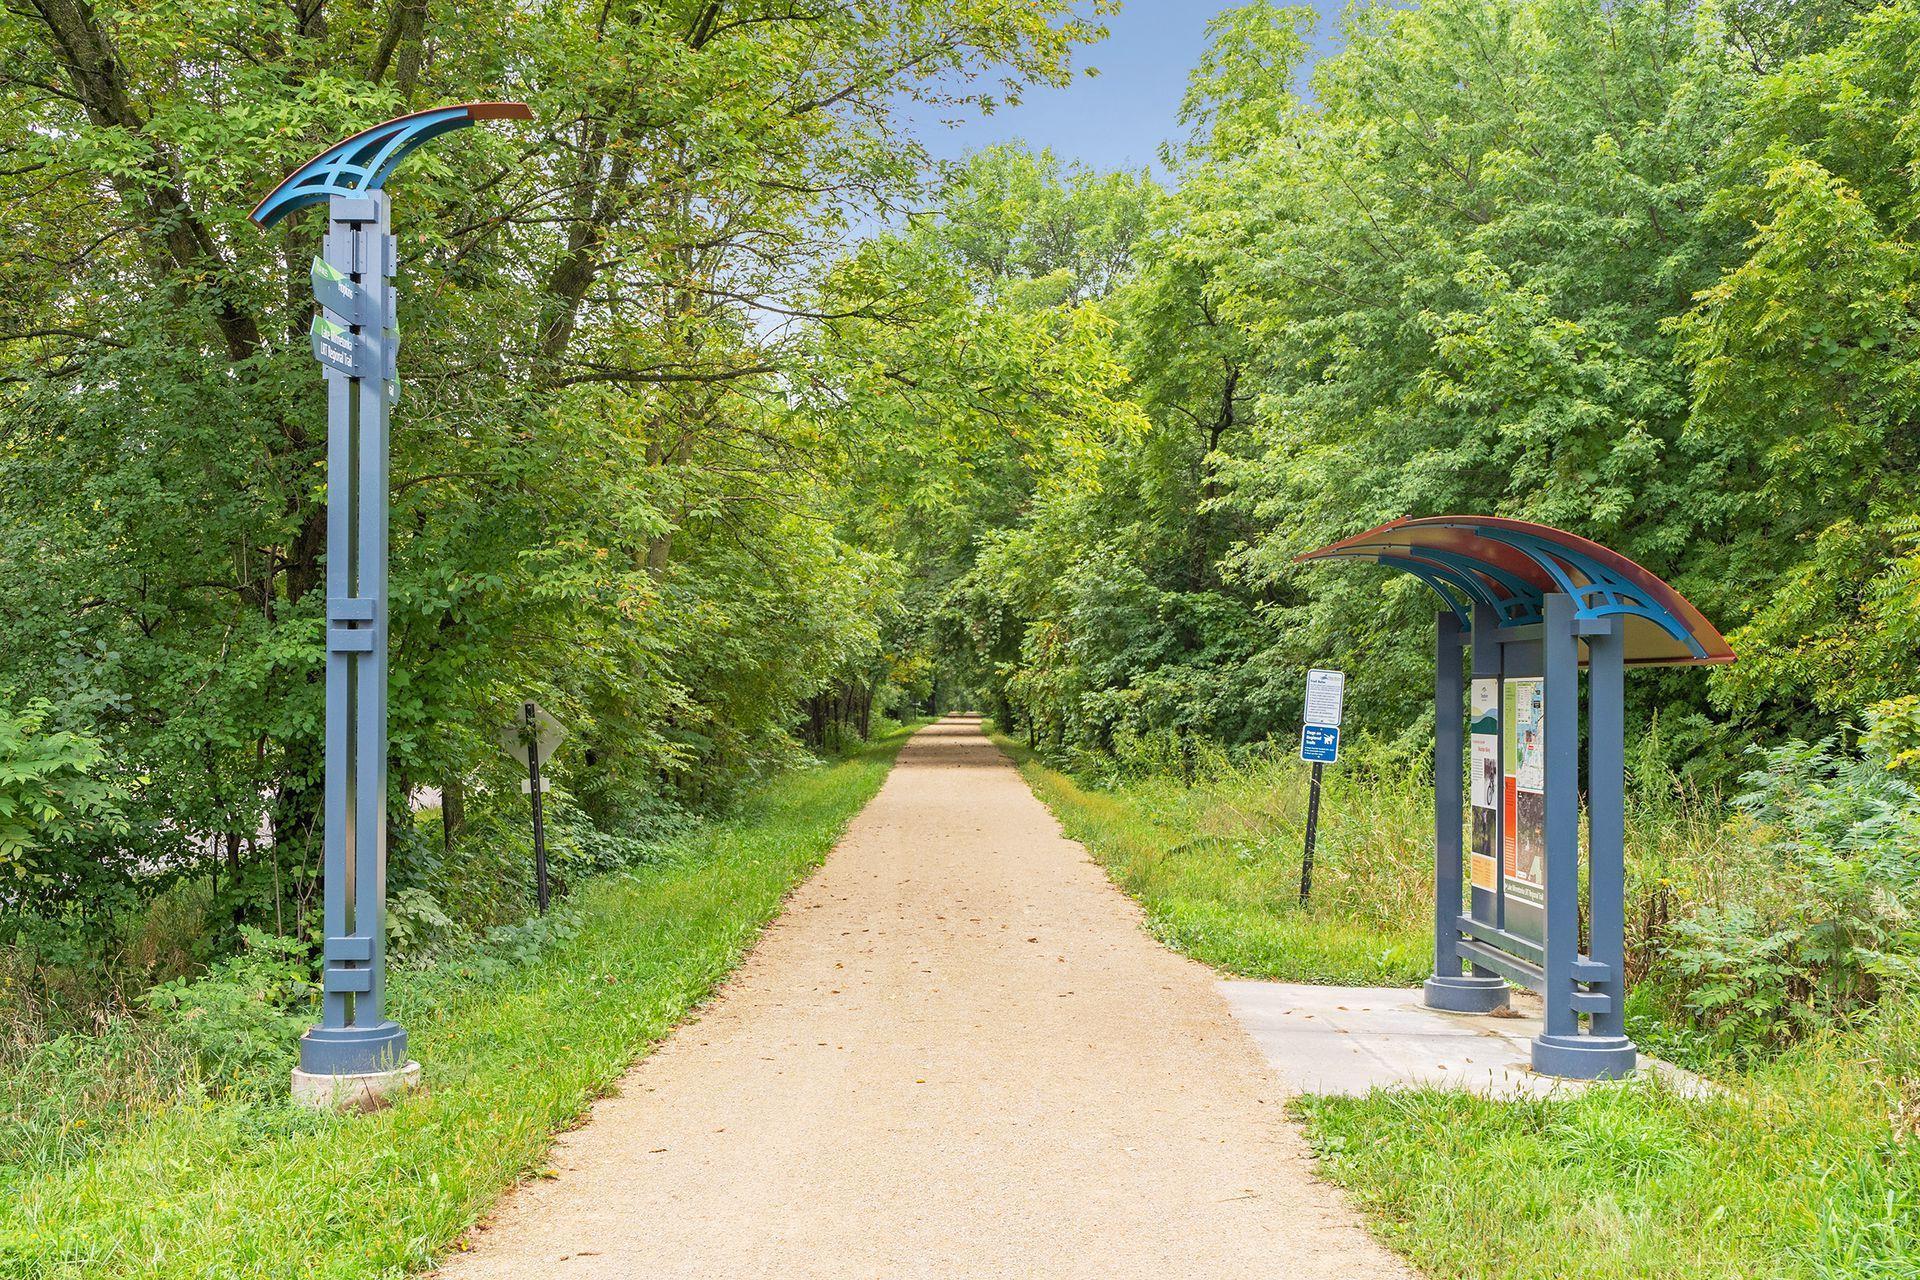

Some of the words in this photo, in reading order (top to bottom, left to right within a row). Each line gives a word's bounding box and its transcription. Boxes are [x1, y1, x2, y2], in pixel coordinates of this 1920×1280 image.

[338, 282, 353, 300] Hopkins
[321, 325, 331, 341] Lake
[330, 329, 353, 351] Minnetonka
[328, 345, 344, 363] Regional
[343, 352, 353, 367] Trail
